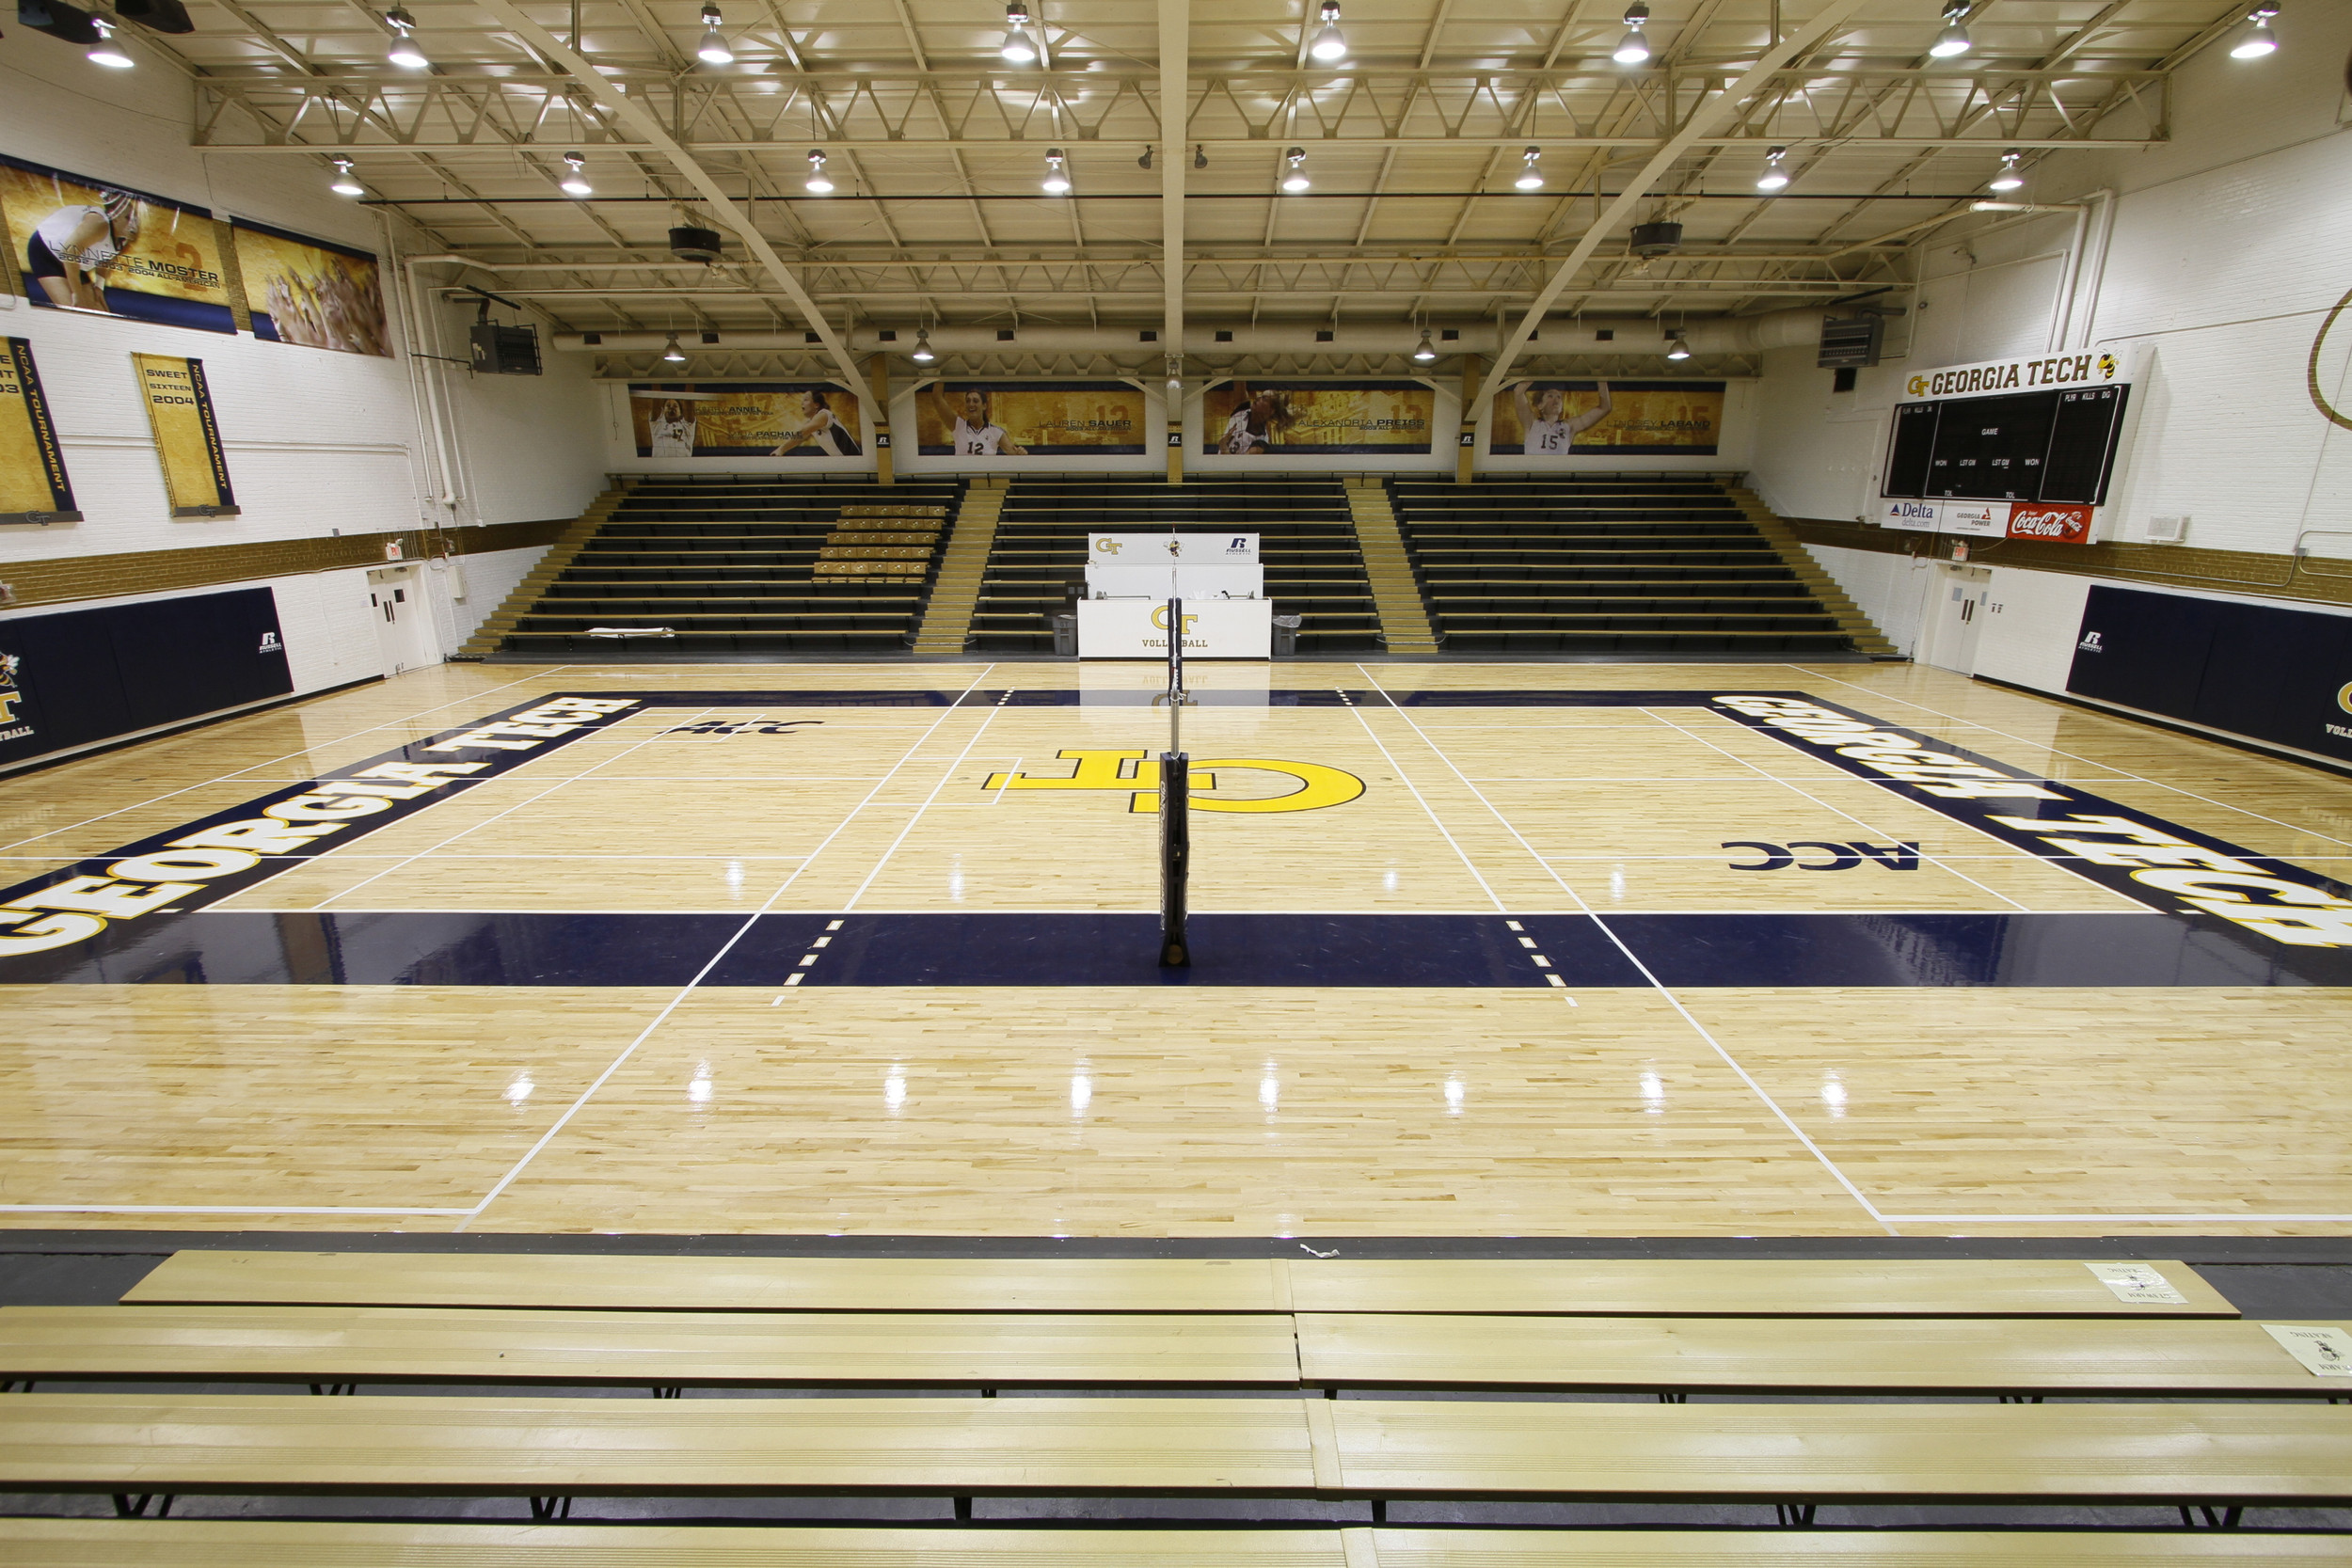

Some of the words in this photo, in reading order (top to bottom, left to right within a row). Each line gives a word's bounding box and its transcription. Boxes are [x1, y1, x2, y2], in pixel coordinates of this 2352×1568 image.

[49, 240, 143, 268] LYNNETTE
[149, 261, 218, 281] MOSTER
[128, 268, 154, 277] 2004
[157, 273, 220, 289] ALL-AMERICAN
[17, 345, 35, 386] NCAA
[146, 369, 188, 379] SWEET
[193, 364, 205, 399] NCAA
[1907, 374, 1930, 397] GT
[1931, 364, 2019, 395] GEORGIA
[2027, 354, 2092, 386] TECH
[150, 383, 192, 391] SIXTEEN
[2082, 392, 2095, 401] KILLS
[2102, 390, 2111, 399] DIG
[152, 395, 195, 405] 2004
[30, 388, 66, 492] TOURNAMENT
[201, 401, 227, 489] TOURNAMENT
[967, 441, 984, 455] 12
[1541, 434, 1558, 450] 15
[1901, 502, 1933, 518] Delta
[1901, 518, 1931, 528] delta.com
[2011, 510, 2068, 537] Coca-Cola
[1096, 538, 1122, 555] GT
[2079, 641, 2103, 650] RUSSELL
[655, 721, 825, 734] ACC
[0, 762, 491, 957] GEORGIA
[421, 697, 643, 752] TECH
[1712, 695, 2074, 801] GEORGIA
[1984, 814, 2352, 948] TECH
[1721, 841, 1919, 871] ACC
